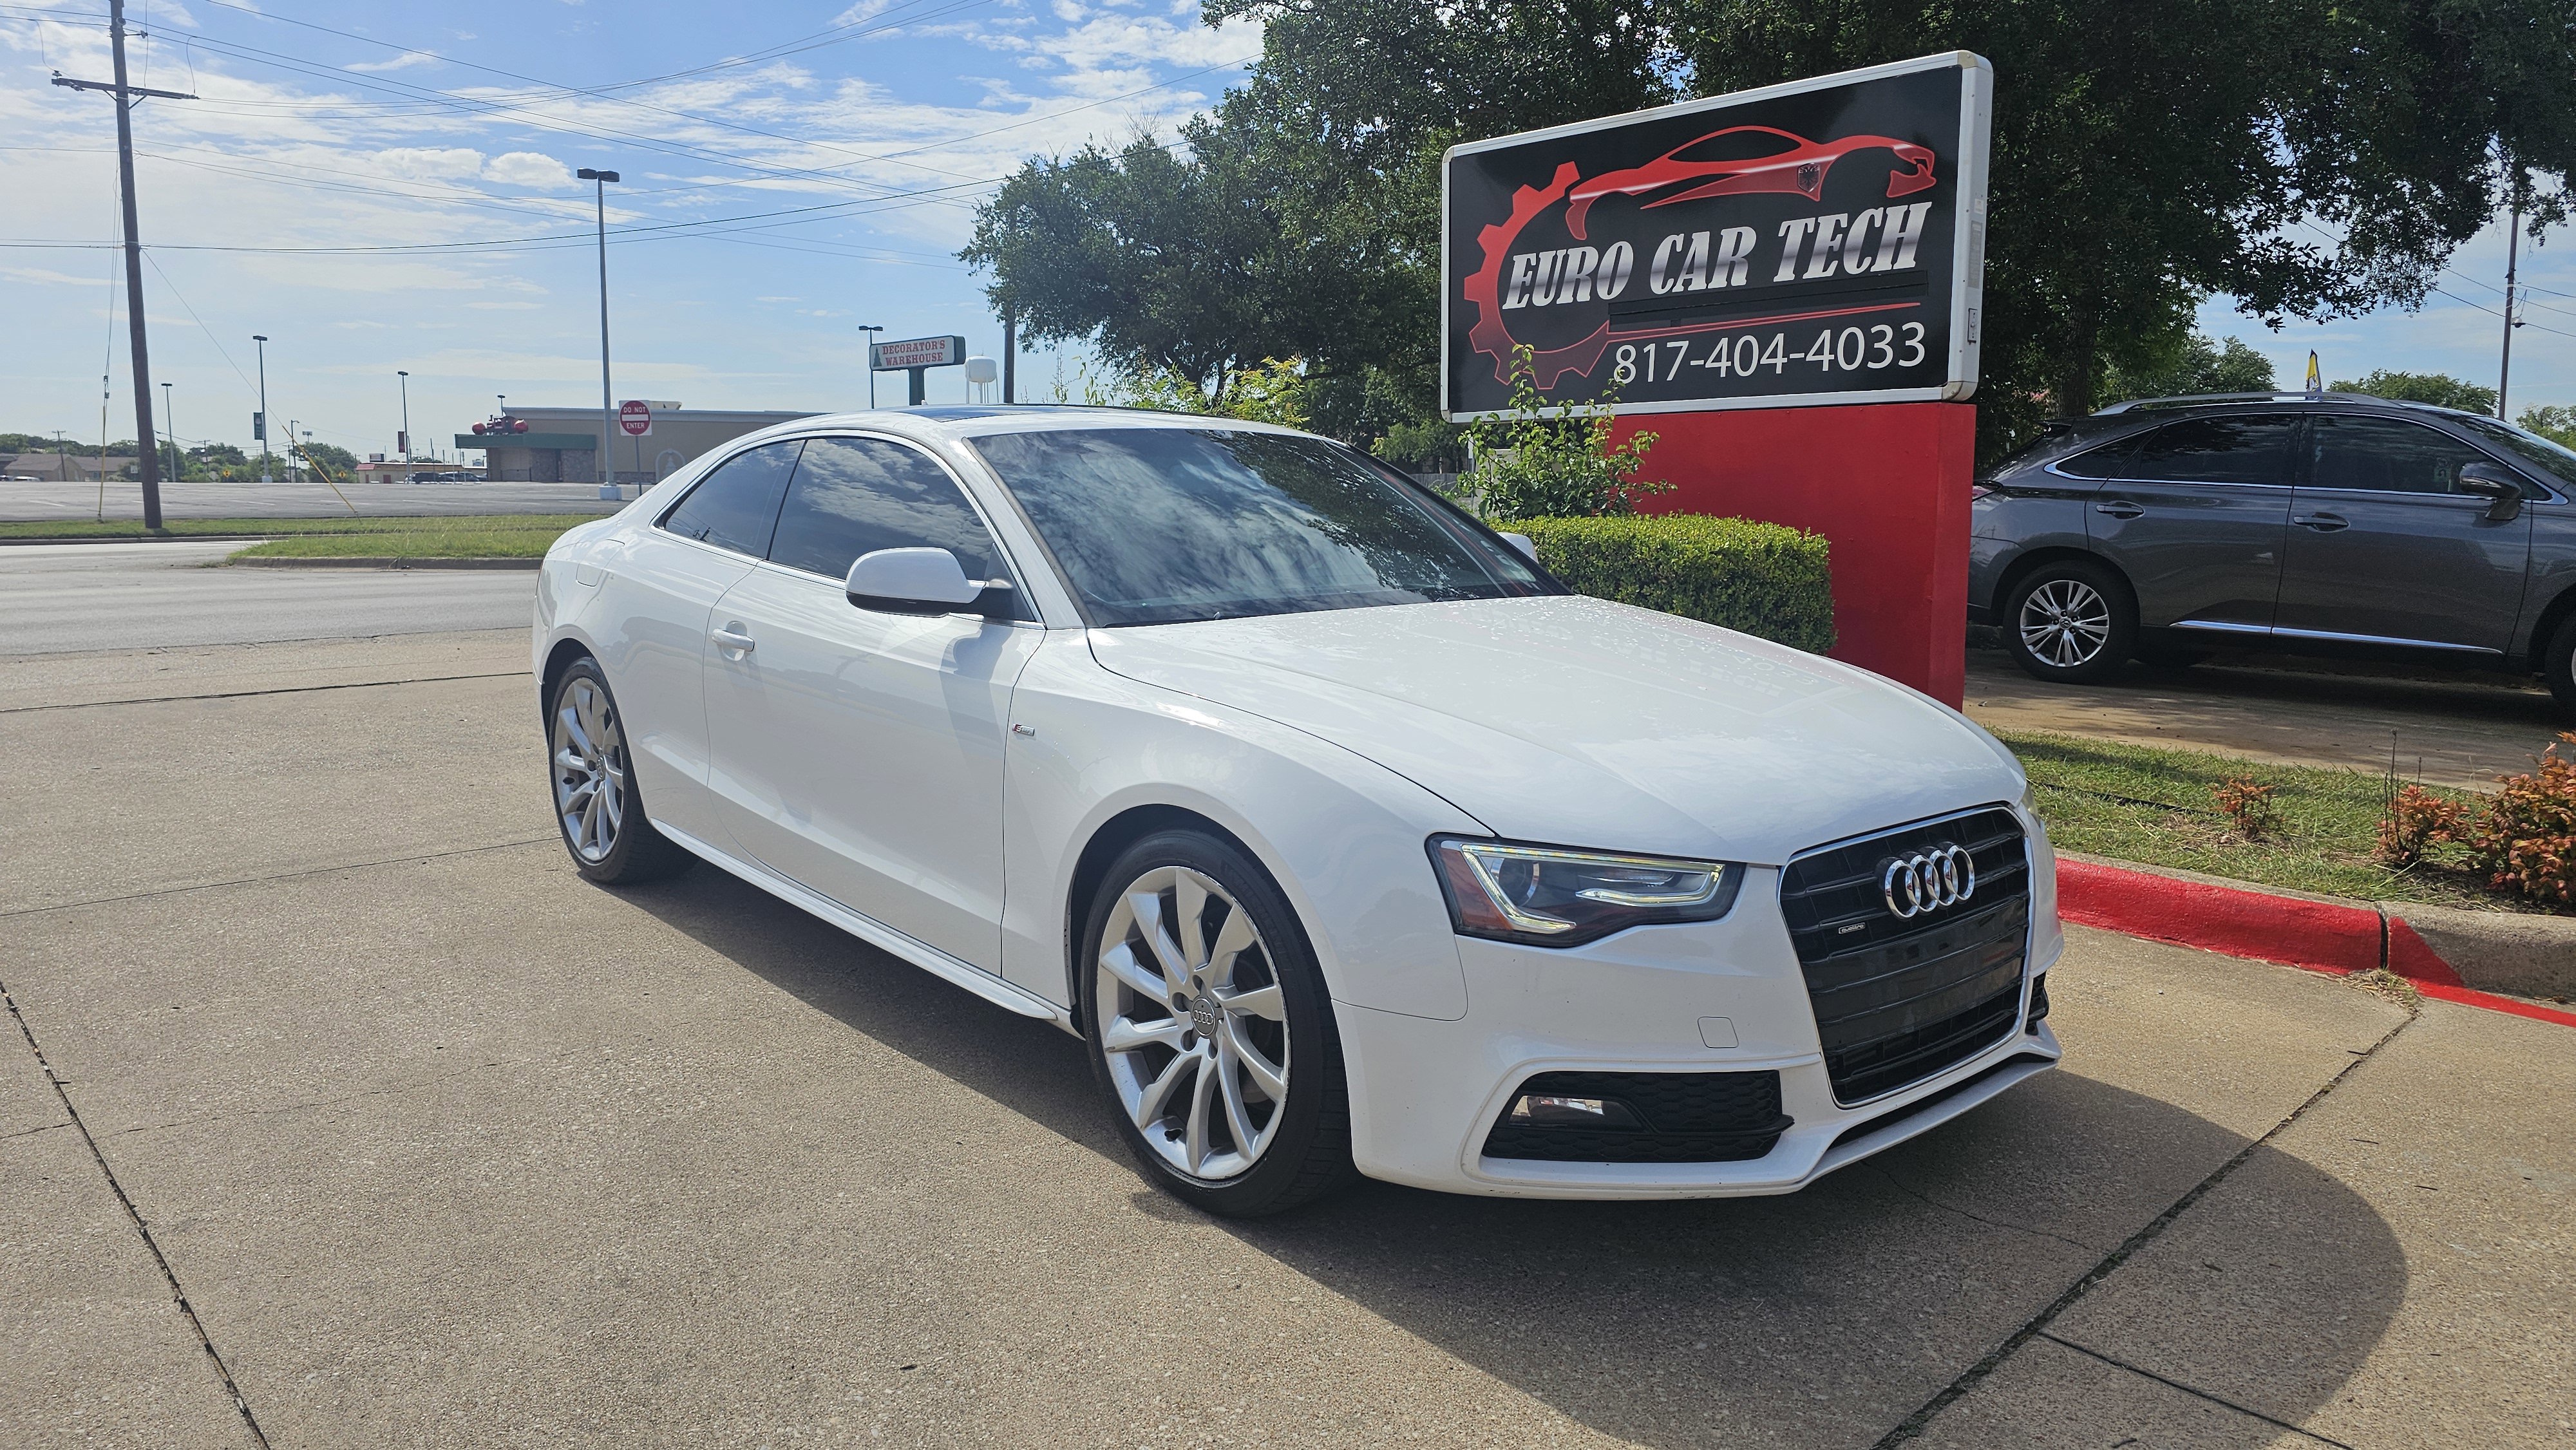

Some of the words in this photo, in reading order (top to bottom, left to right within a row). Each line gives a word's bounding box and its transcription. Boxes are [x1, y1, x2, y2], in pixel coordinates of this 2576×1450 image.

[1502, 241, 1634, 310] EURO
[1650, 226, 1756, 295] CAR
[1774, 202, 1932, 283] TECH
[882, 339, 945, 355] DECORATOR'S
[1614, 321, 1926, 384] 817-404-4033
[886, 352, 943, 366] WAREHOUSE
[1841, 924, 1864, 933] quattro
